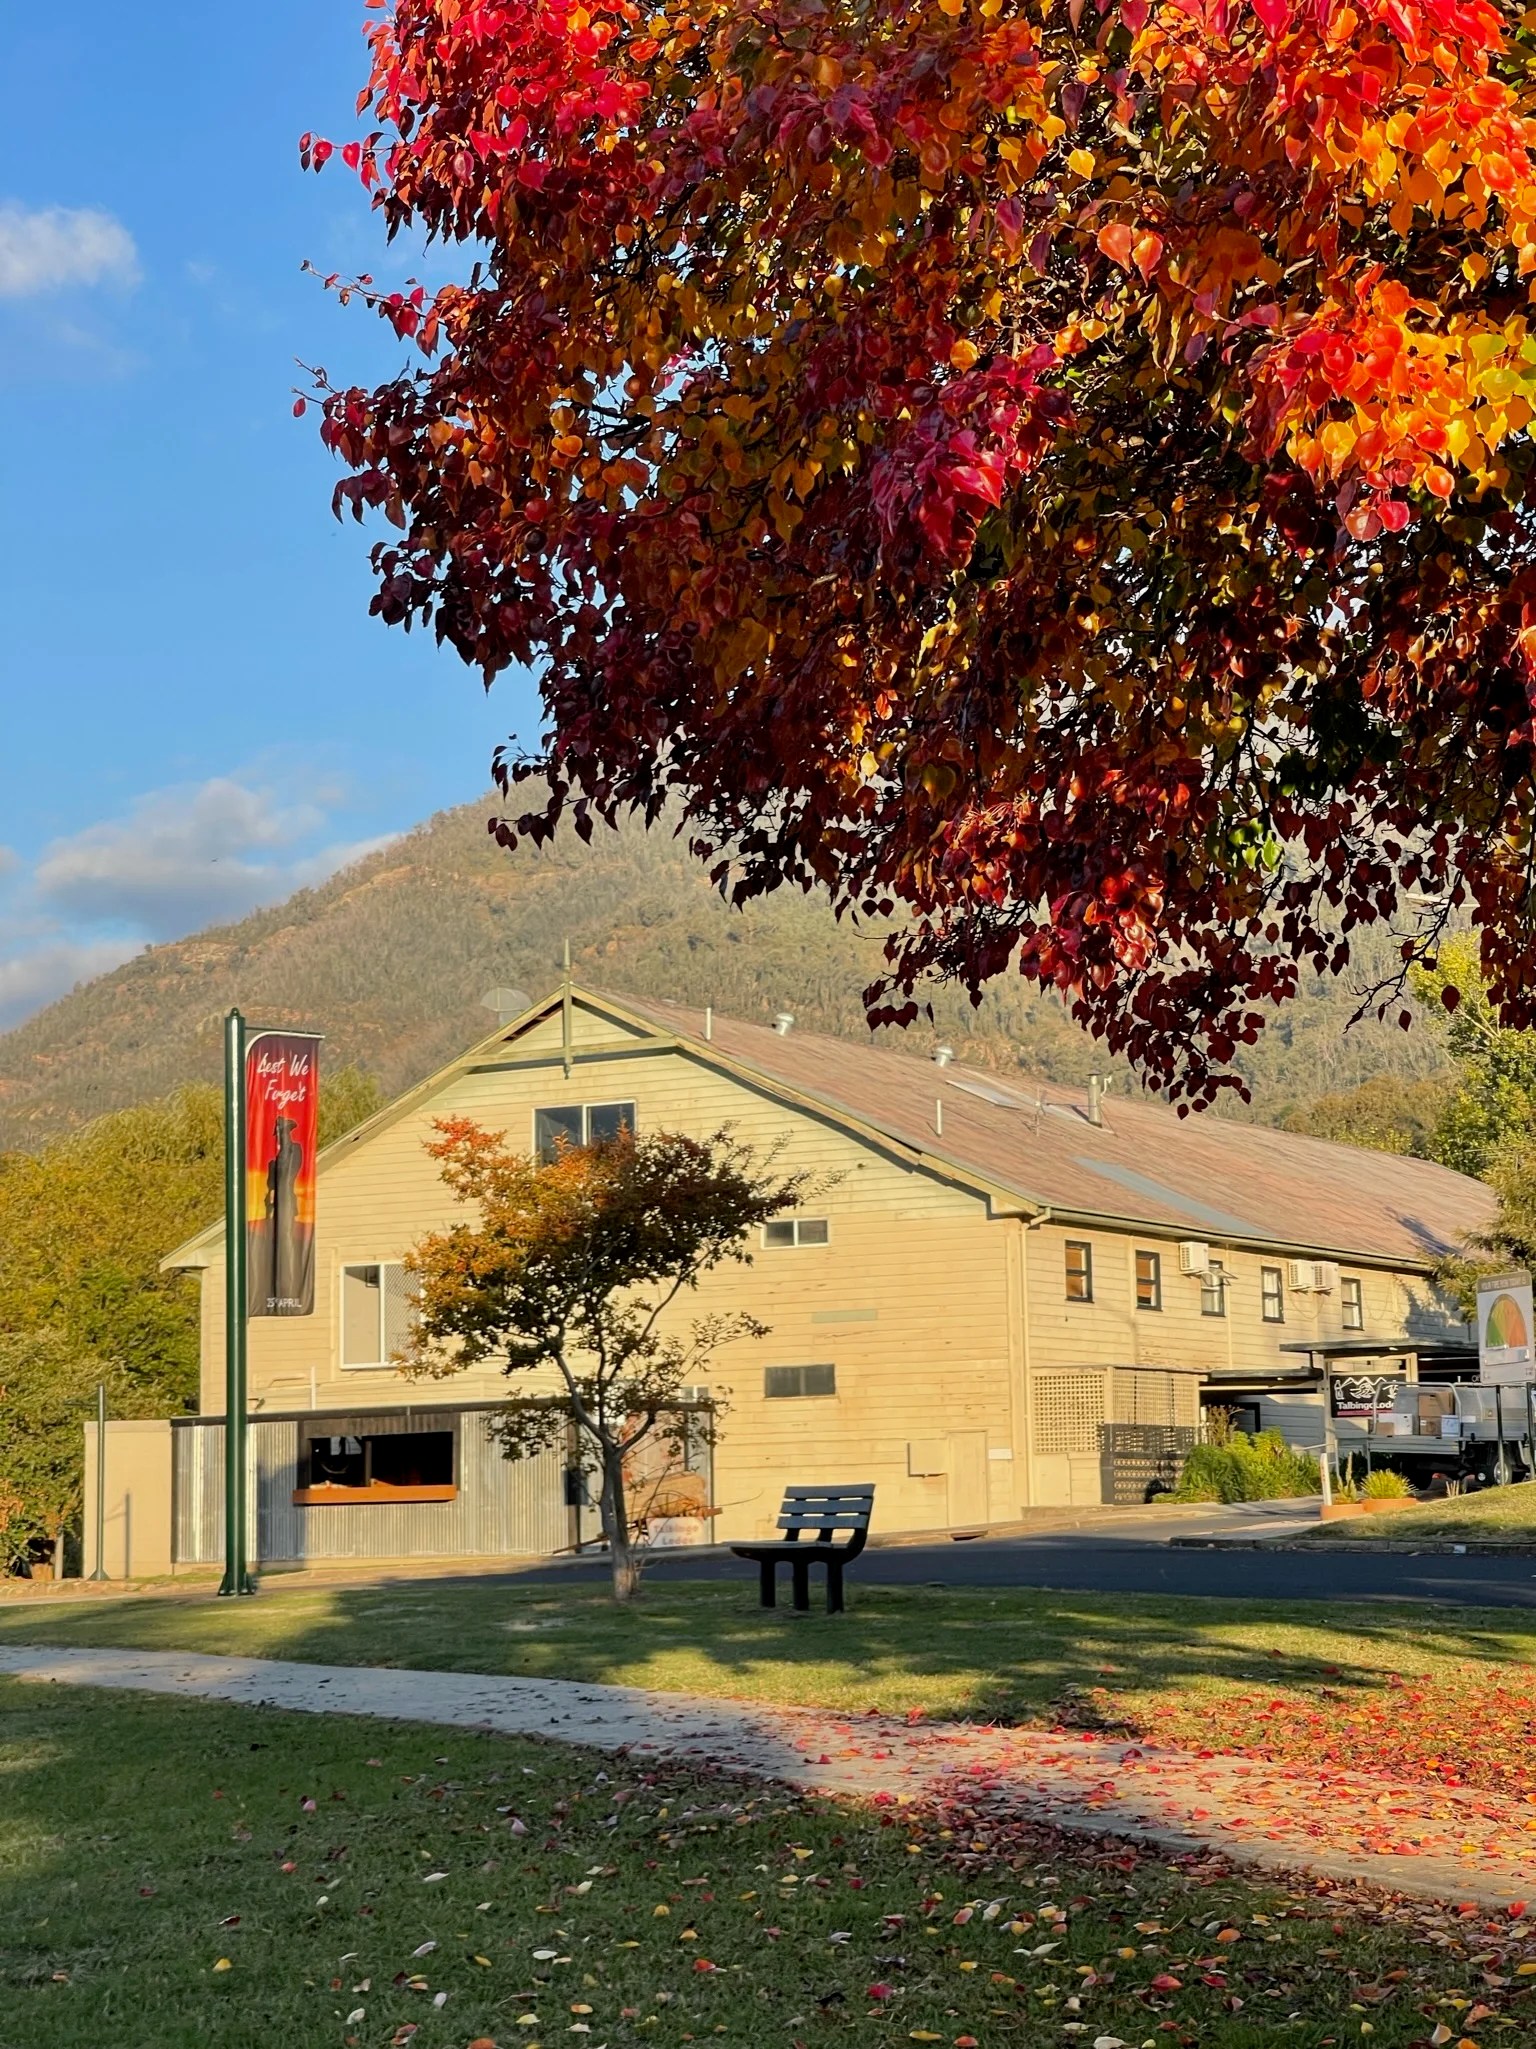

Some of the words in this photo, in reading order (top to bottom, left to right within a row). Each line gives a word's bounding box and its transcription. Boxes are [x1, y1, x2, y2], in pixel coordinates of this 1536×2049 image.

[256, 1052, 286, 1078] Lest
[289, 1053, 309, 1077] We
[264, 1079, 306, 1110] Forget
[278, 1297, 302, 1308] APRIL
[1336, 1401, 1374, 1411] Talbingo
